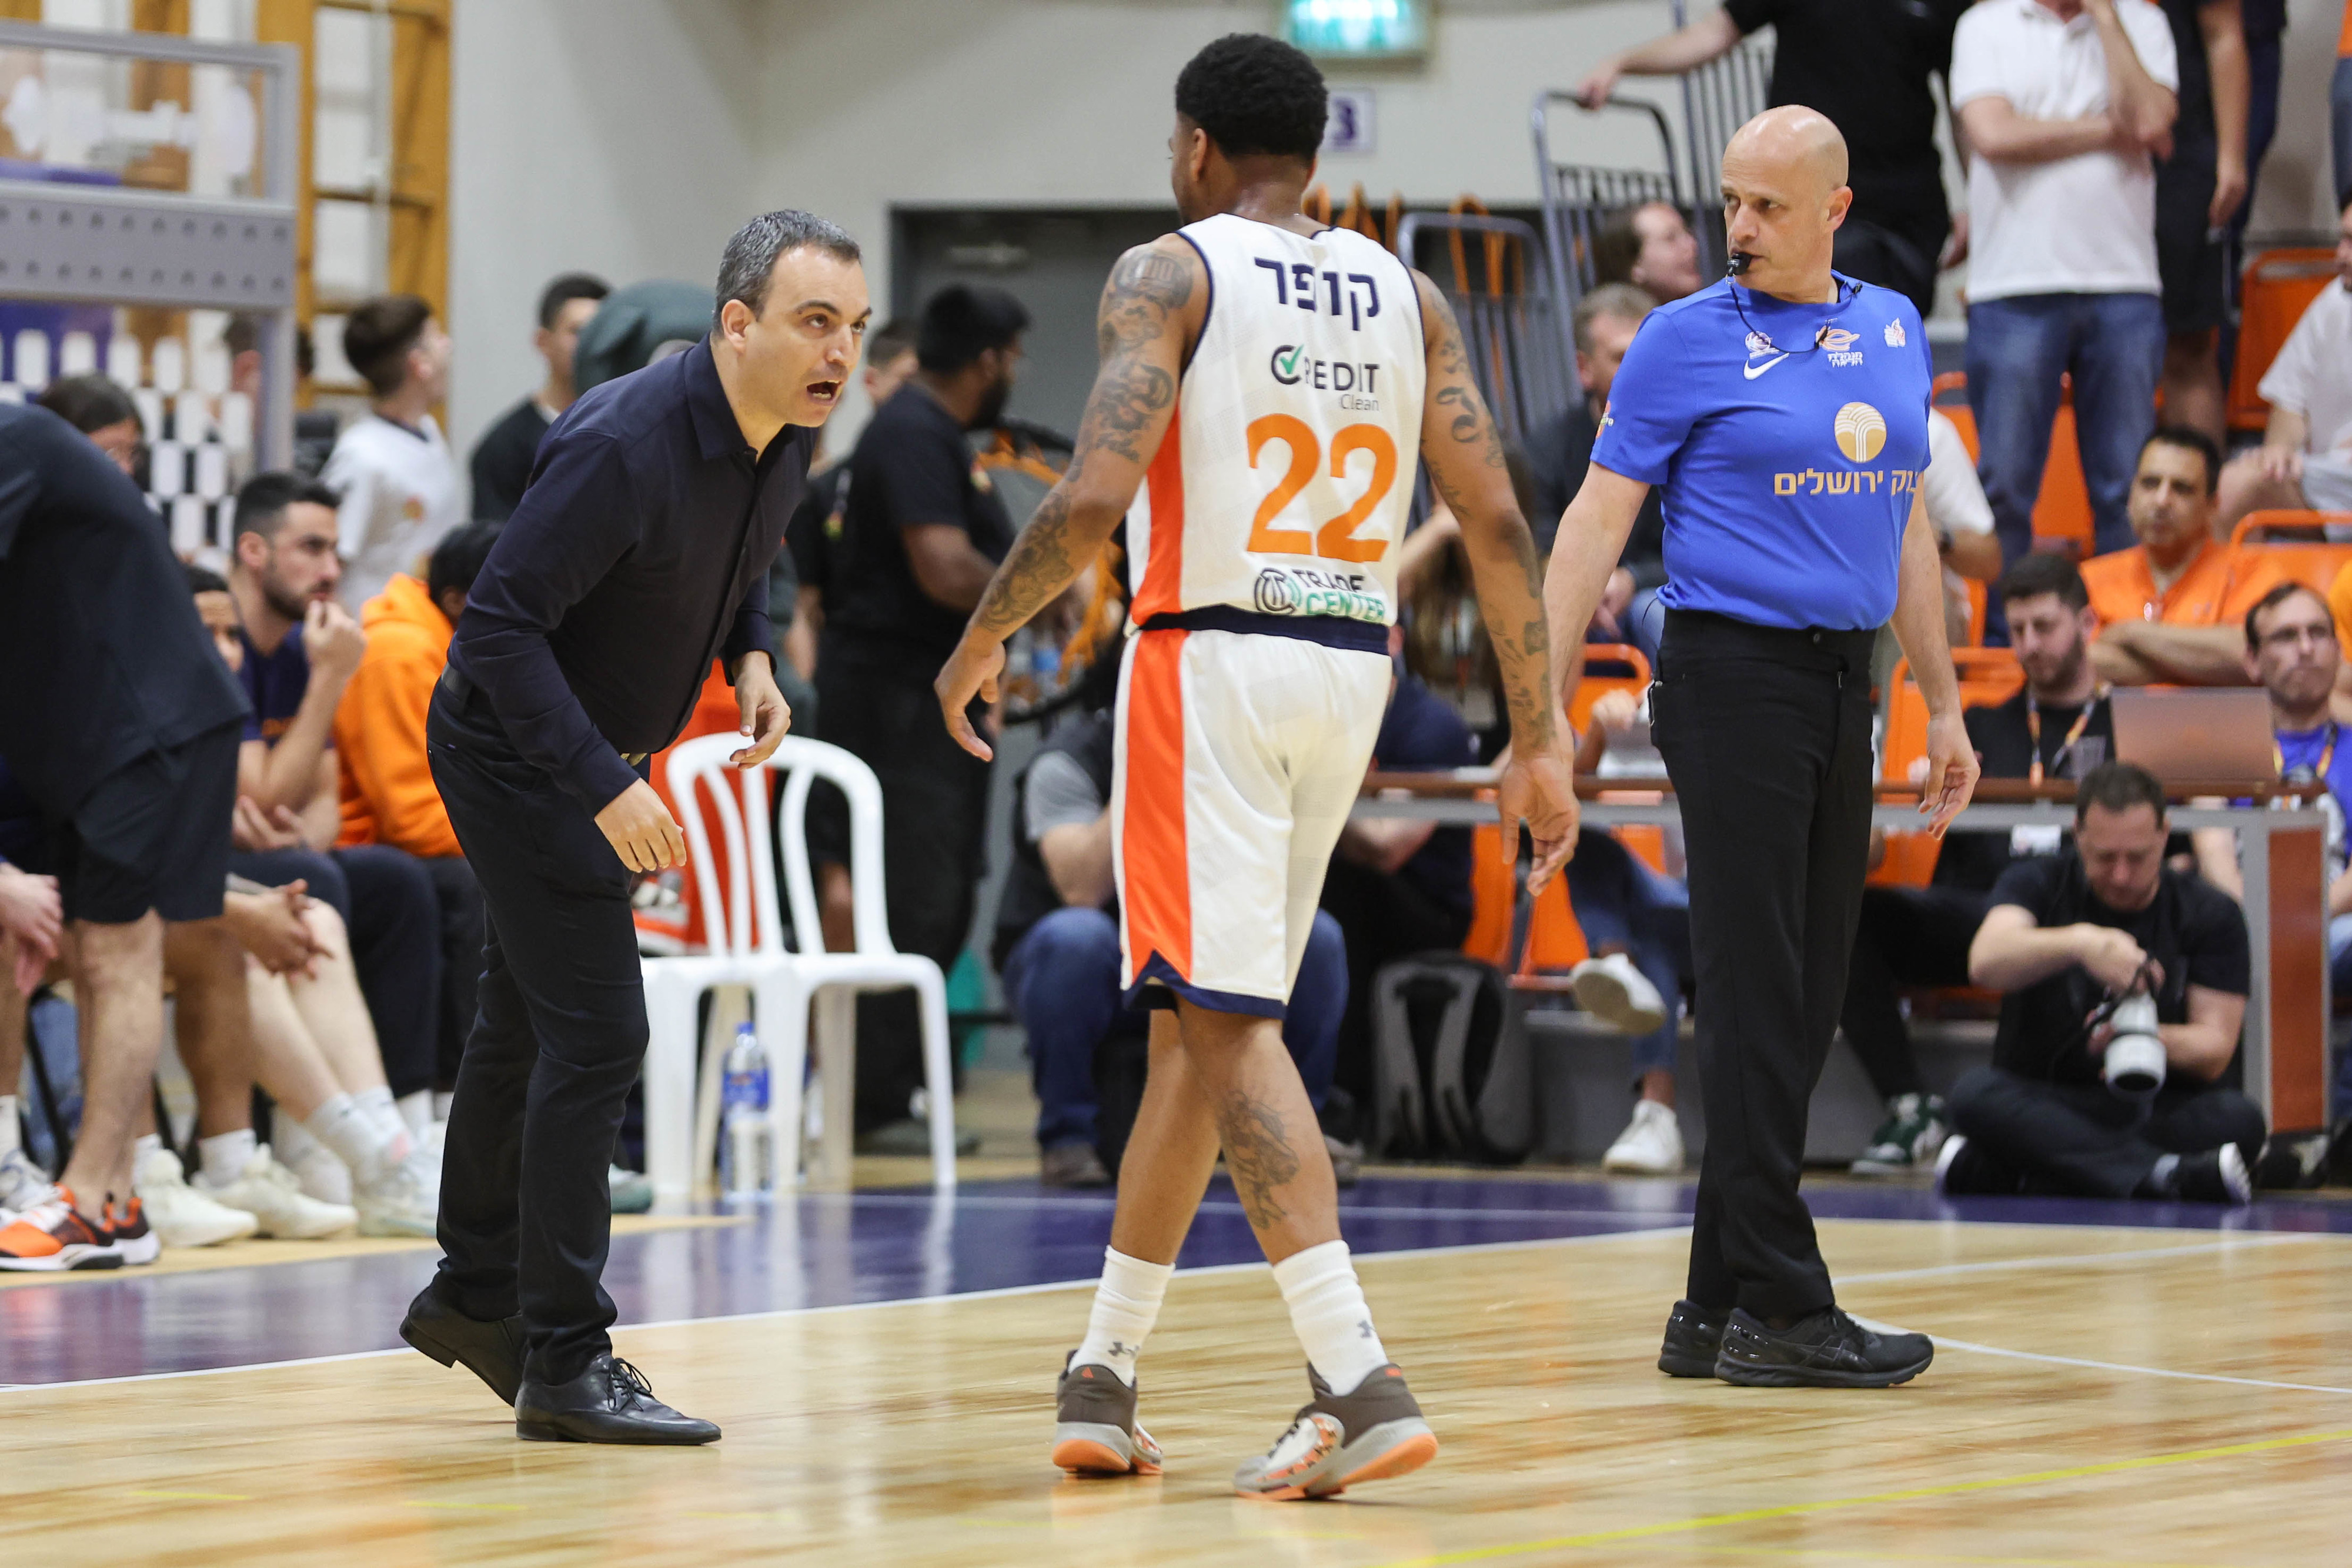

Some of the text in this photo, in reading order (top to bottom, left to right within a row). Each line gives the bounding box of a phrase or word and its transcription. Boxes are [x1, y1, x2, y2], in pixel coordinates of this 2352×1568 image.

[1254, 256, 1381, 332] קופר
[1271, 343, 1380, 393] CREDIT
[1340, 393, 1379, 411] Clean
[1247, 413, 1398, 563] 22
[1774, 468, 1883, 496] ירושלים
